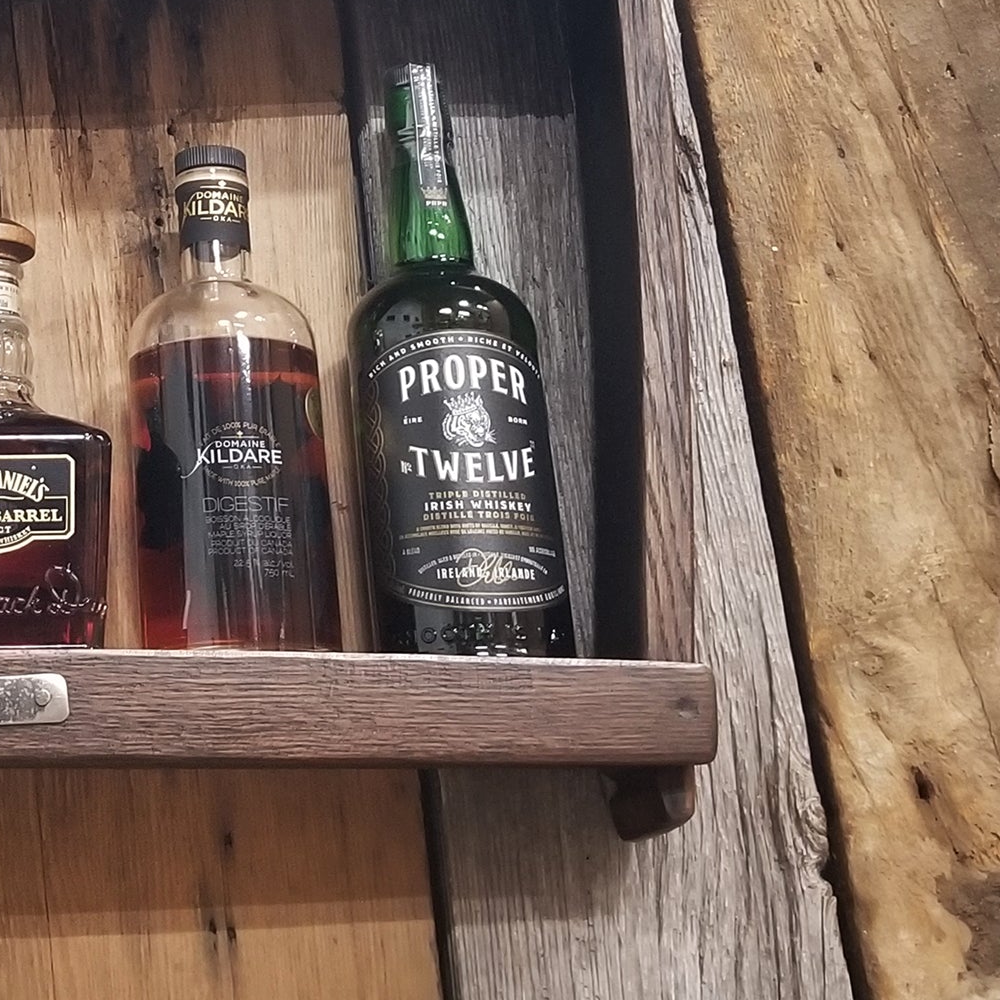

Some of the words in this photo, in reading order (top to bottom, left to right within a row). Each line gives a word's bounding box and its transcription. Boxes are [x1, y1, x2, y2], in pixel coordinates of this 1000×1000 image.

[196, 190, 243, 202] DOMAINE
[388, 348, 407, 361] AND
[410, 336, 455, 351] SMOOTH
[467, 336, 498, 347] RICHE
[501, 343, 513, 352] ET
[398, 354, 528, 405] PROPER
[507, 415, 528, 425] BORN
[214, 440, 267, 448] DOMAINE
[193, 448, 283, 466] KILDARE
[408, 445, 536, 483] TWELVE
[428, 490, 468, 499] TRIPLE
[472, 490, 526, 500] DISTILLED
[202, 496, 290, 513] DIGESTIF
[424, 501, 464, 511] IRISH
[470, 500, 532, 512] WHISKEY
[478, 510, 511, 519] TROIS
[436, 567, 482, 579] IRELAND
[408, 587, 442, 602] PROPERLY
[445, 594, 485, 606] BALANCED
